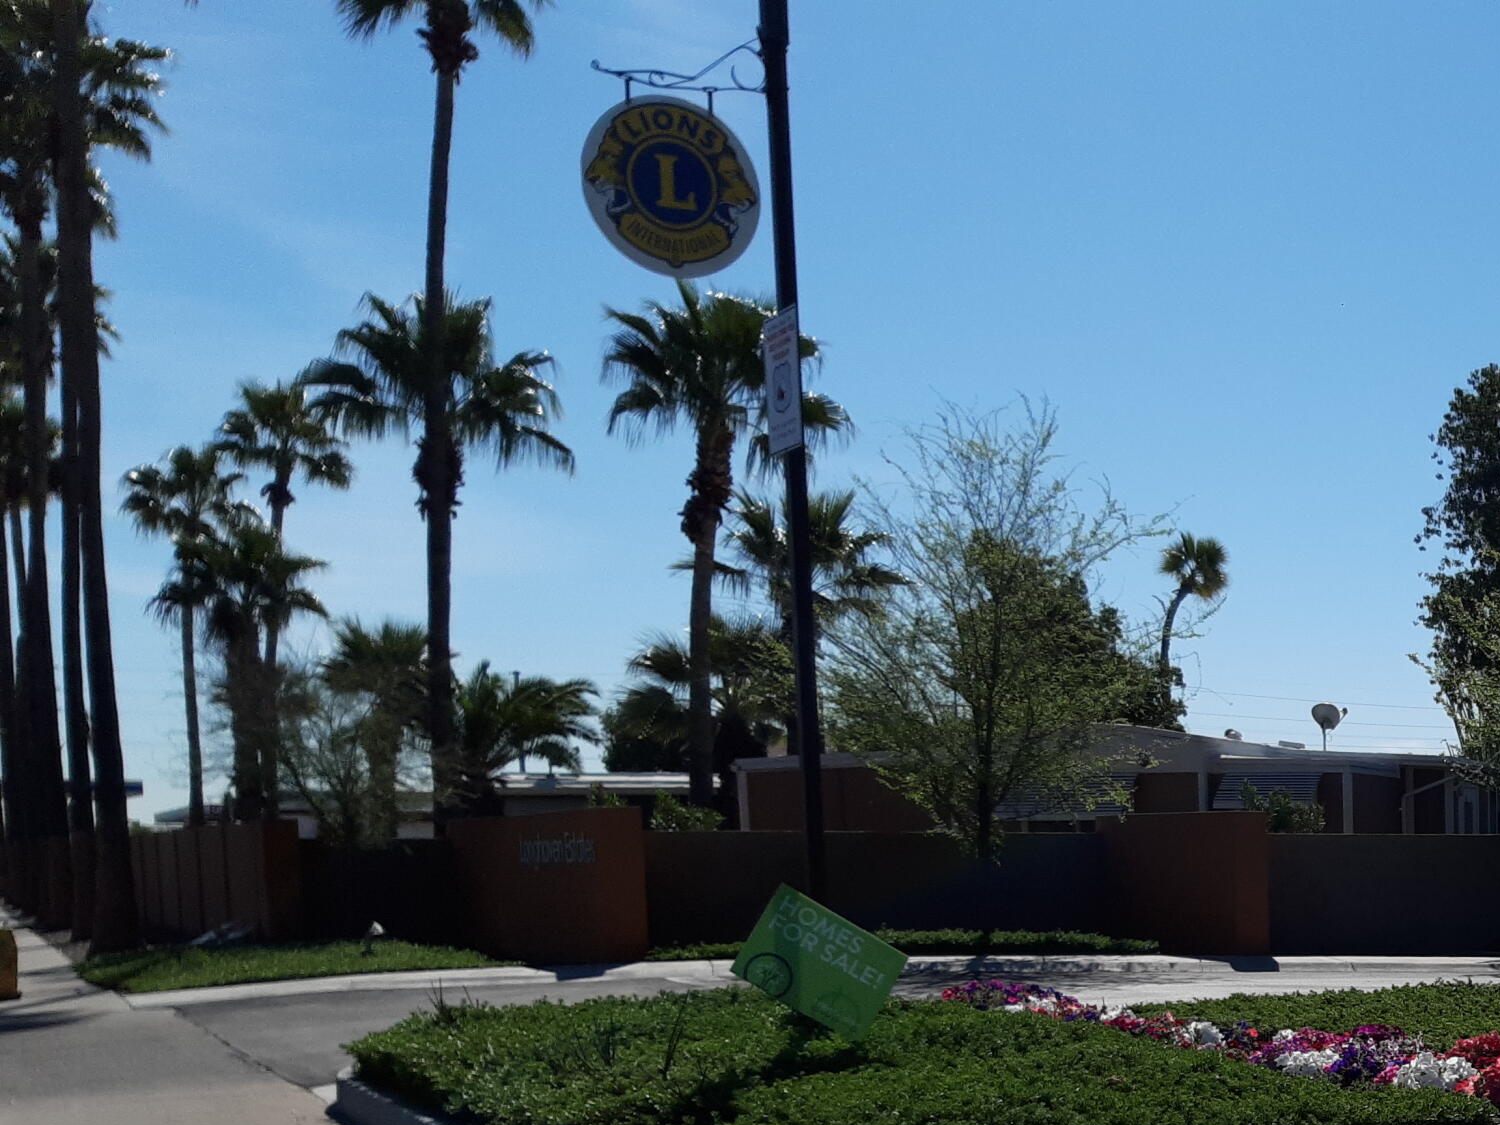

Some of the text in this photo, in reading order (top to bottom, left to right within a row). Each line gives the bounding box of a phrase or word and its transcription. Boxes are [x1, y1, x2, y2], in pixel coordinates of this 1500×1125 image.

[623, 108, 718, 150] LIONS
[654, 153, 698, 211] L
[626, 220, 722, 255] INTERNATIONAL
[769, 914, 887, 989] FOR SALE!
[778, 895, 866, 955] HOMES
